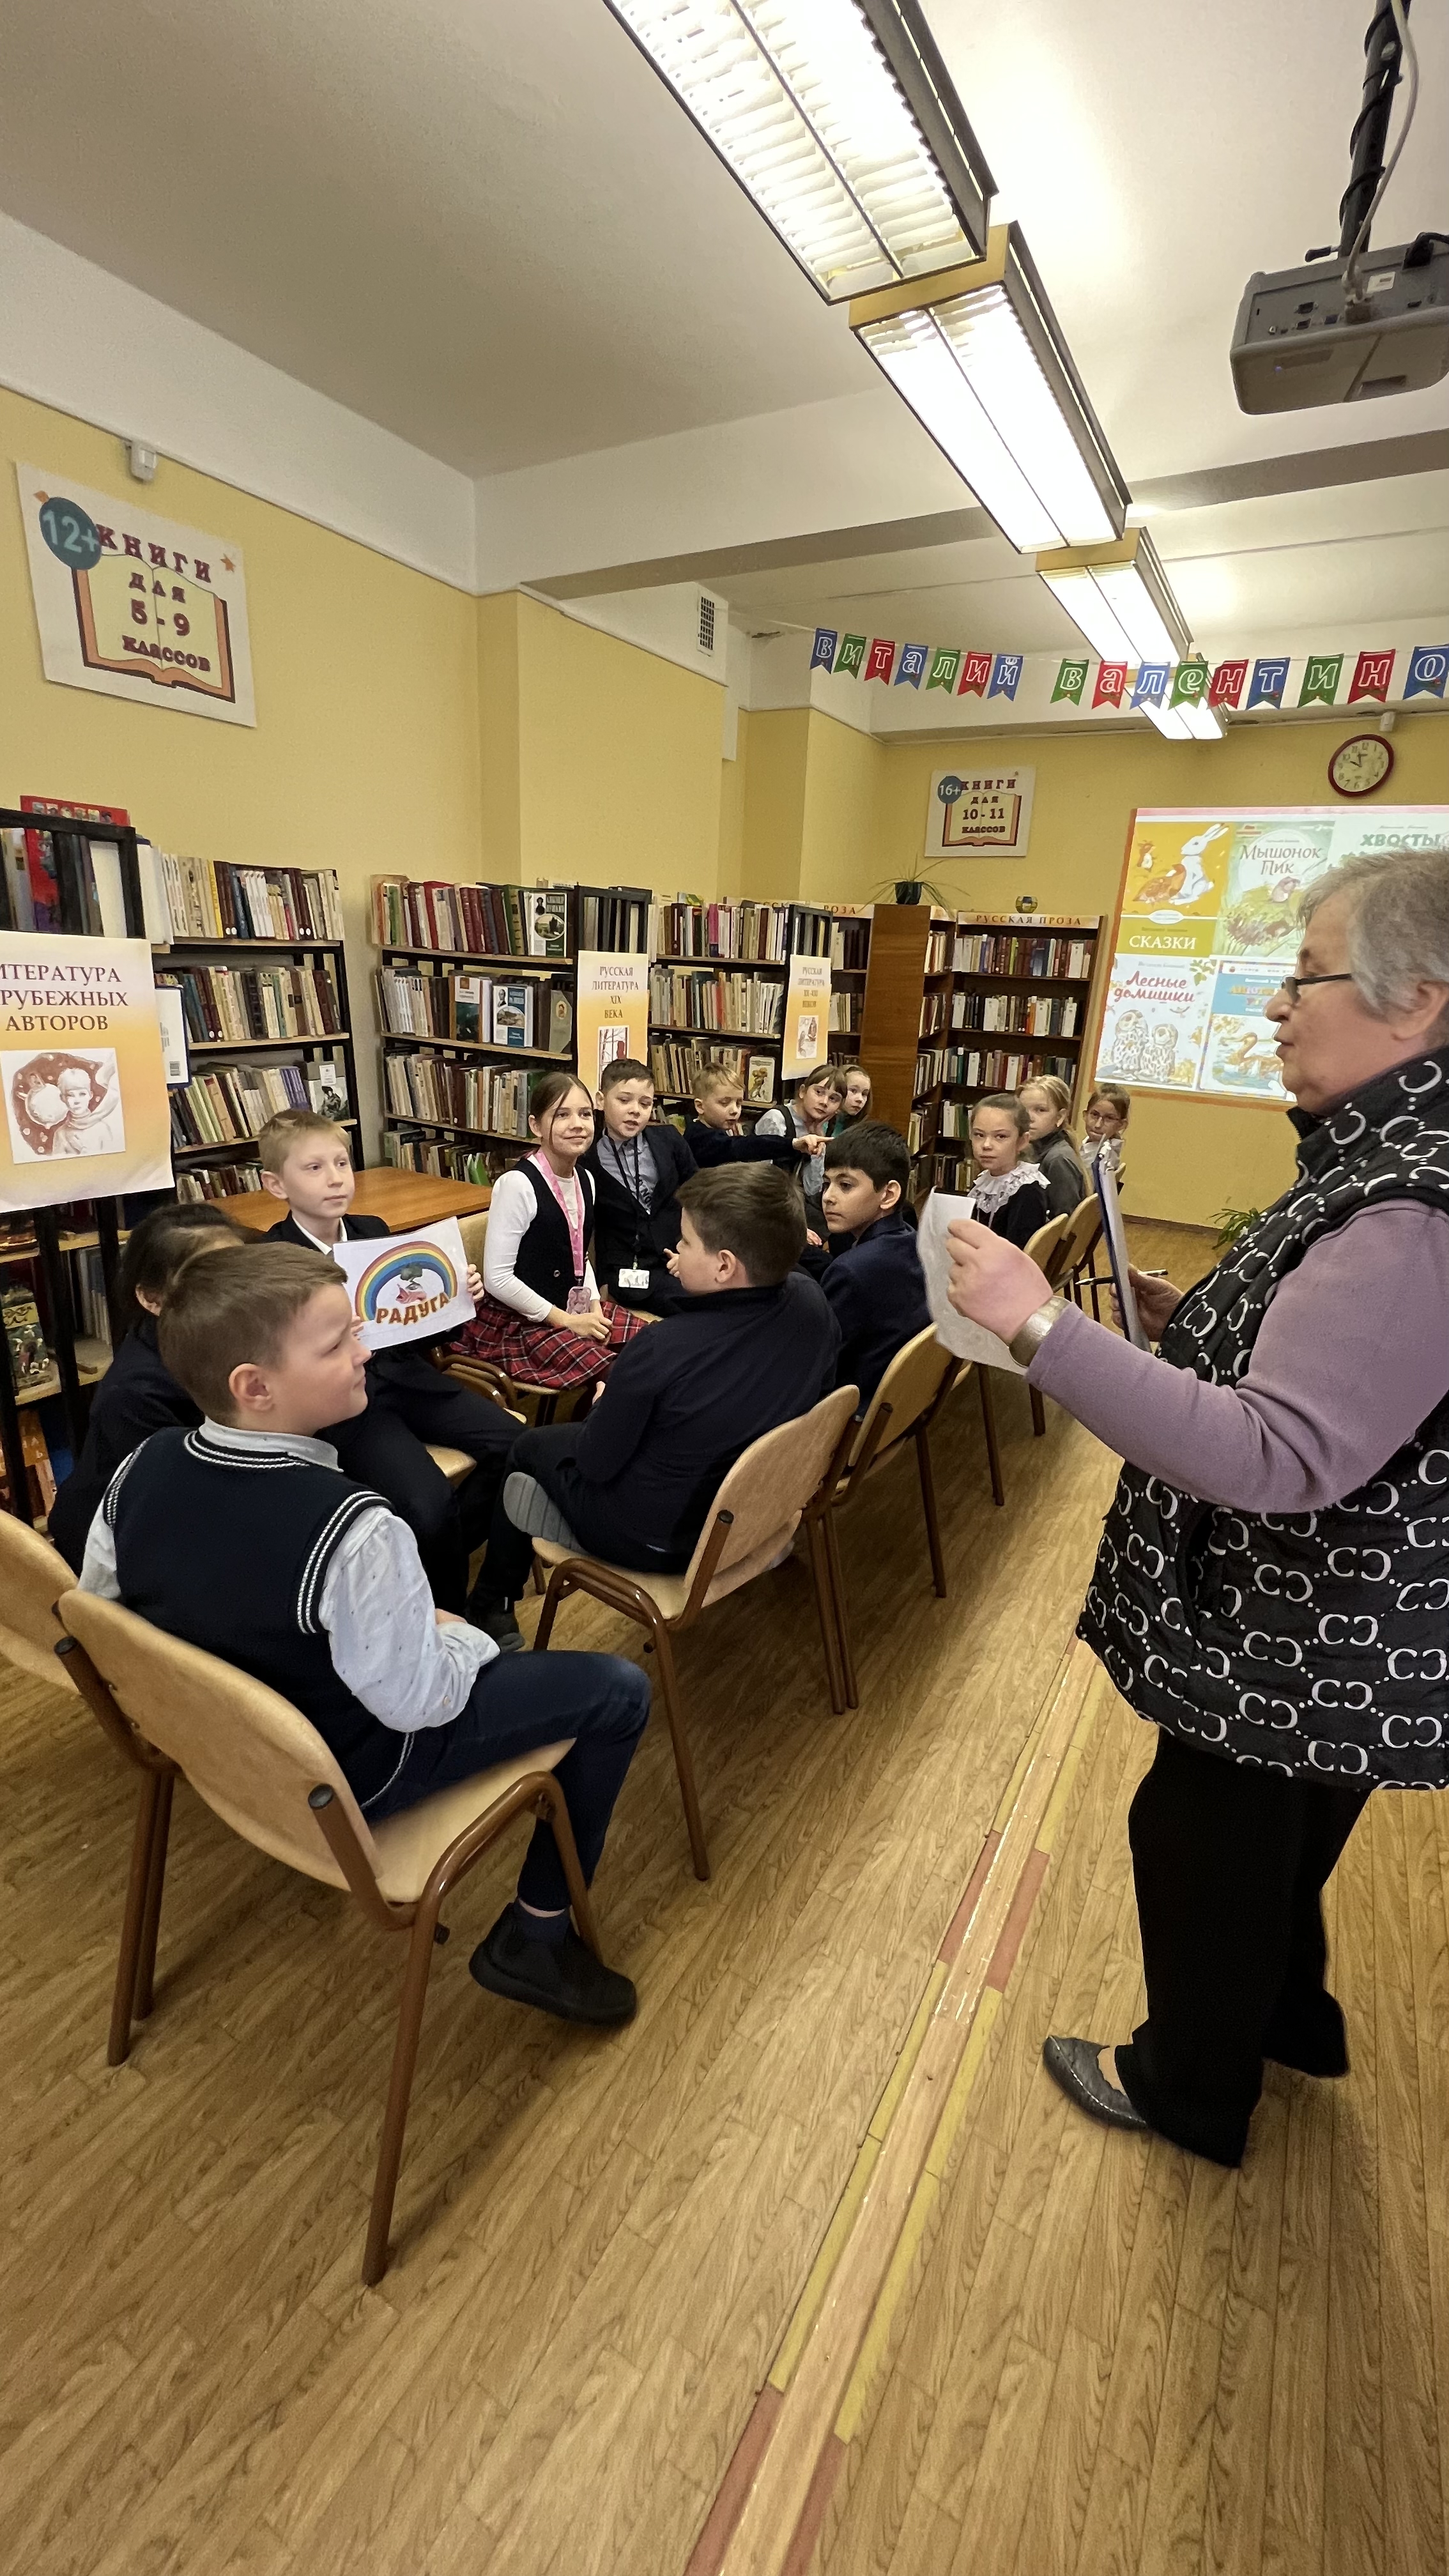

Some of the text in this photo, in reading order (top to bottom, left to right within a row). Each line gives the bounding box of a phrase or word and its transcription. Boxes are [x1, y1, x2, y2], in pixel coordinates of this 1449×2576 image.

[42, 509, 100, 554] 12+
[96, 523, 211, 583] КНИГИ
[128, 572, 187, 604] ДЛЯ
[121, 634, 211, 672] КЛАССОВ
[939, 784, 962, 796] 16+
[960, 779, 1016, 791] КНИГИ
[970, 796, 999, 805] ДЛЯ
[961, 825, 1006, 834] КЛАССОВ
[1359, 834, 1441, 847] ХВОСТЫ
[1239, 844, 1323, 861] Мышонок
[1260, 860, 1295, 876] Пик
[824, 904, 856, 915] РОЗА
[976, 914, 1082, 925] РУССКАЯ ПРОЗА
[1129, 935, 1197, 950] СКАЗКИ
[599, 965, 634, 979] РУССКАЯ
[1126, 970, 1188, 989] Лесные
[592, 980, 639, 993] ЛИТЕРАТУРА
[0, 989, 129, 1011] РУБЕЖНЫХ
[610, 995, 622, 1005] XIX
[1114, 988, 1196, 1003] домишки
[604, 1009, 624, 1019] ВЕКА
[5, 1015, 109, 1031] АВТОРОВ
[376, 1291, 450, 1326] РАДУГА
